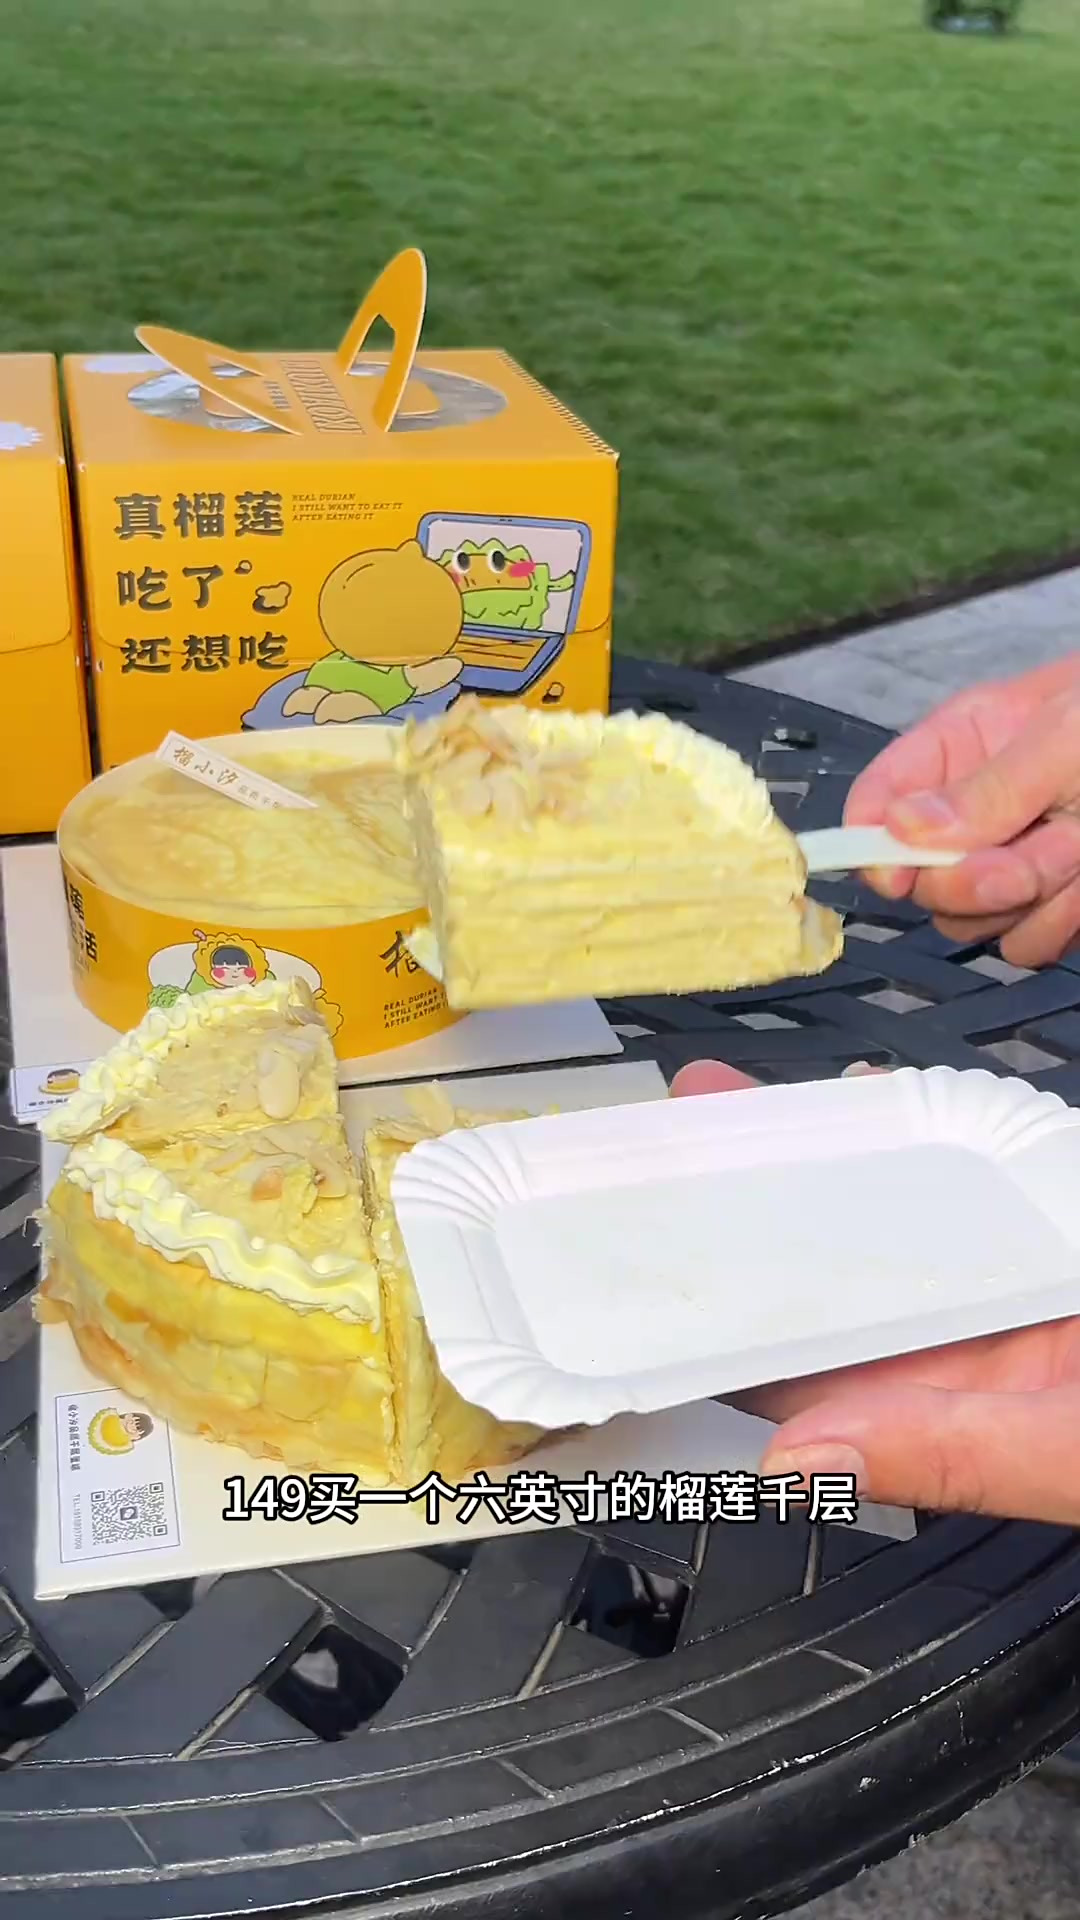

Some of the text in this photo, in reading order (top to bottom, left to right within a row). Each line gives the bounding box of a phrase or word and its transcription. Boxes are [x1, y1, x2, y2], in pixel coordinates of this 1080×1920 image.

[320, 493, 356, 501] DURIAN
[328, 503, 356, 511] WANT
[392, 502, 403, 510] IT
[114, 490, 284, 540] 真榴莲
[116, 564, 225, 611] 吃了
[120, 631, 290, 674] 还想吃
[384, 1000, 405, 1010] REAL
[390, 1007, 412, 1018] STILL
[384, 1016, 411, 1028] AFTER
